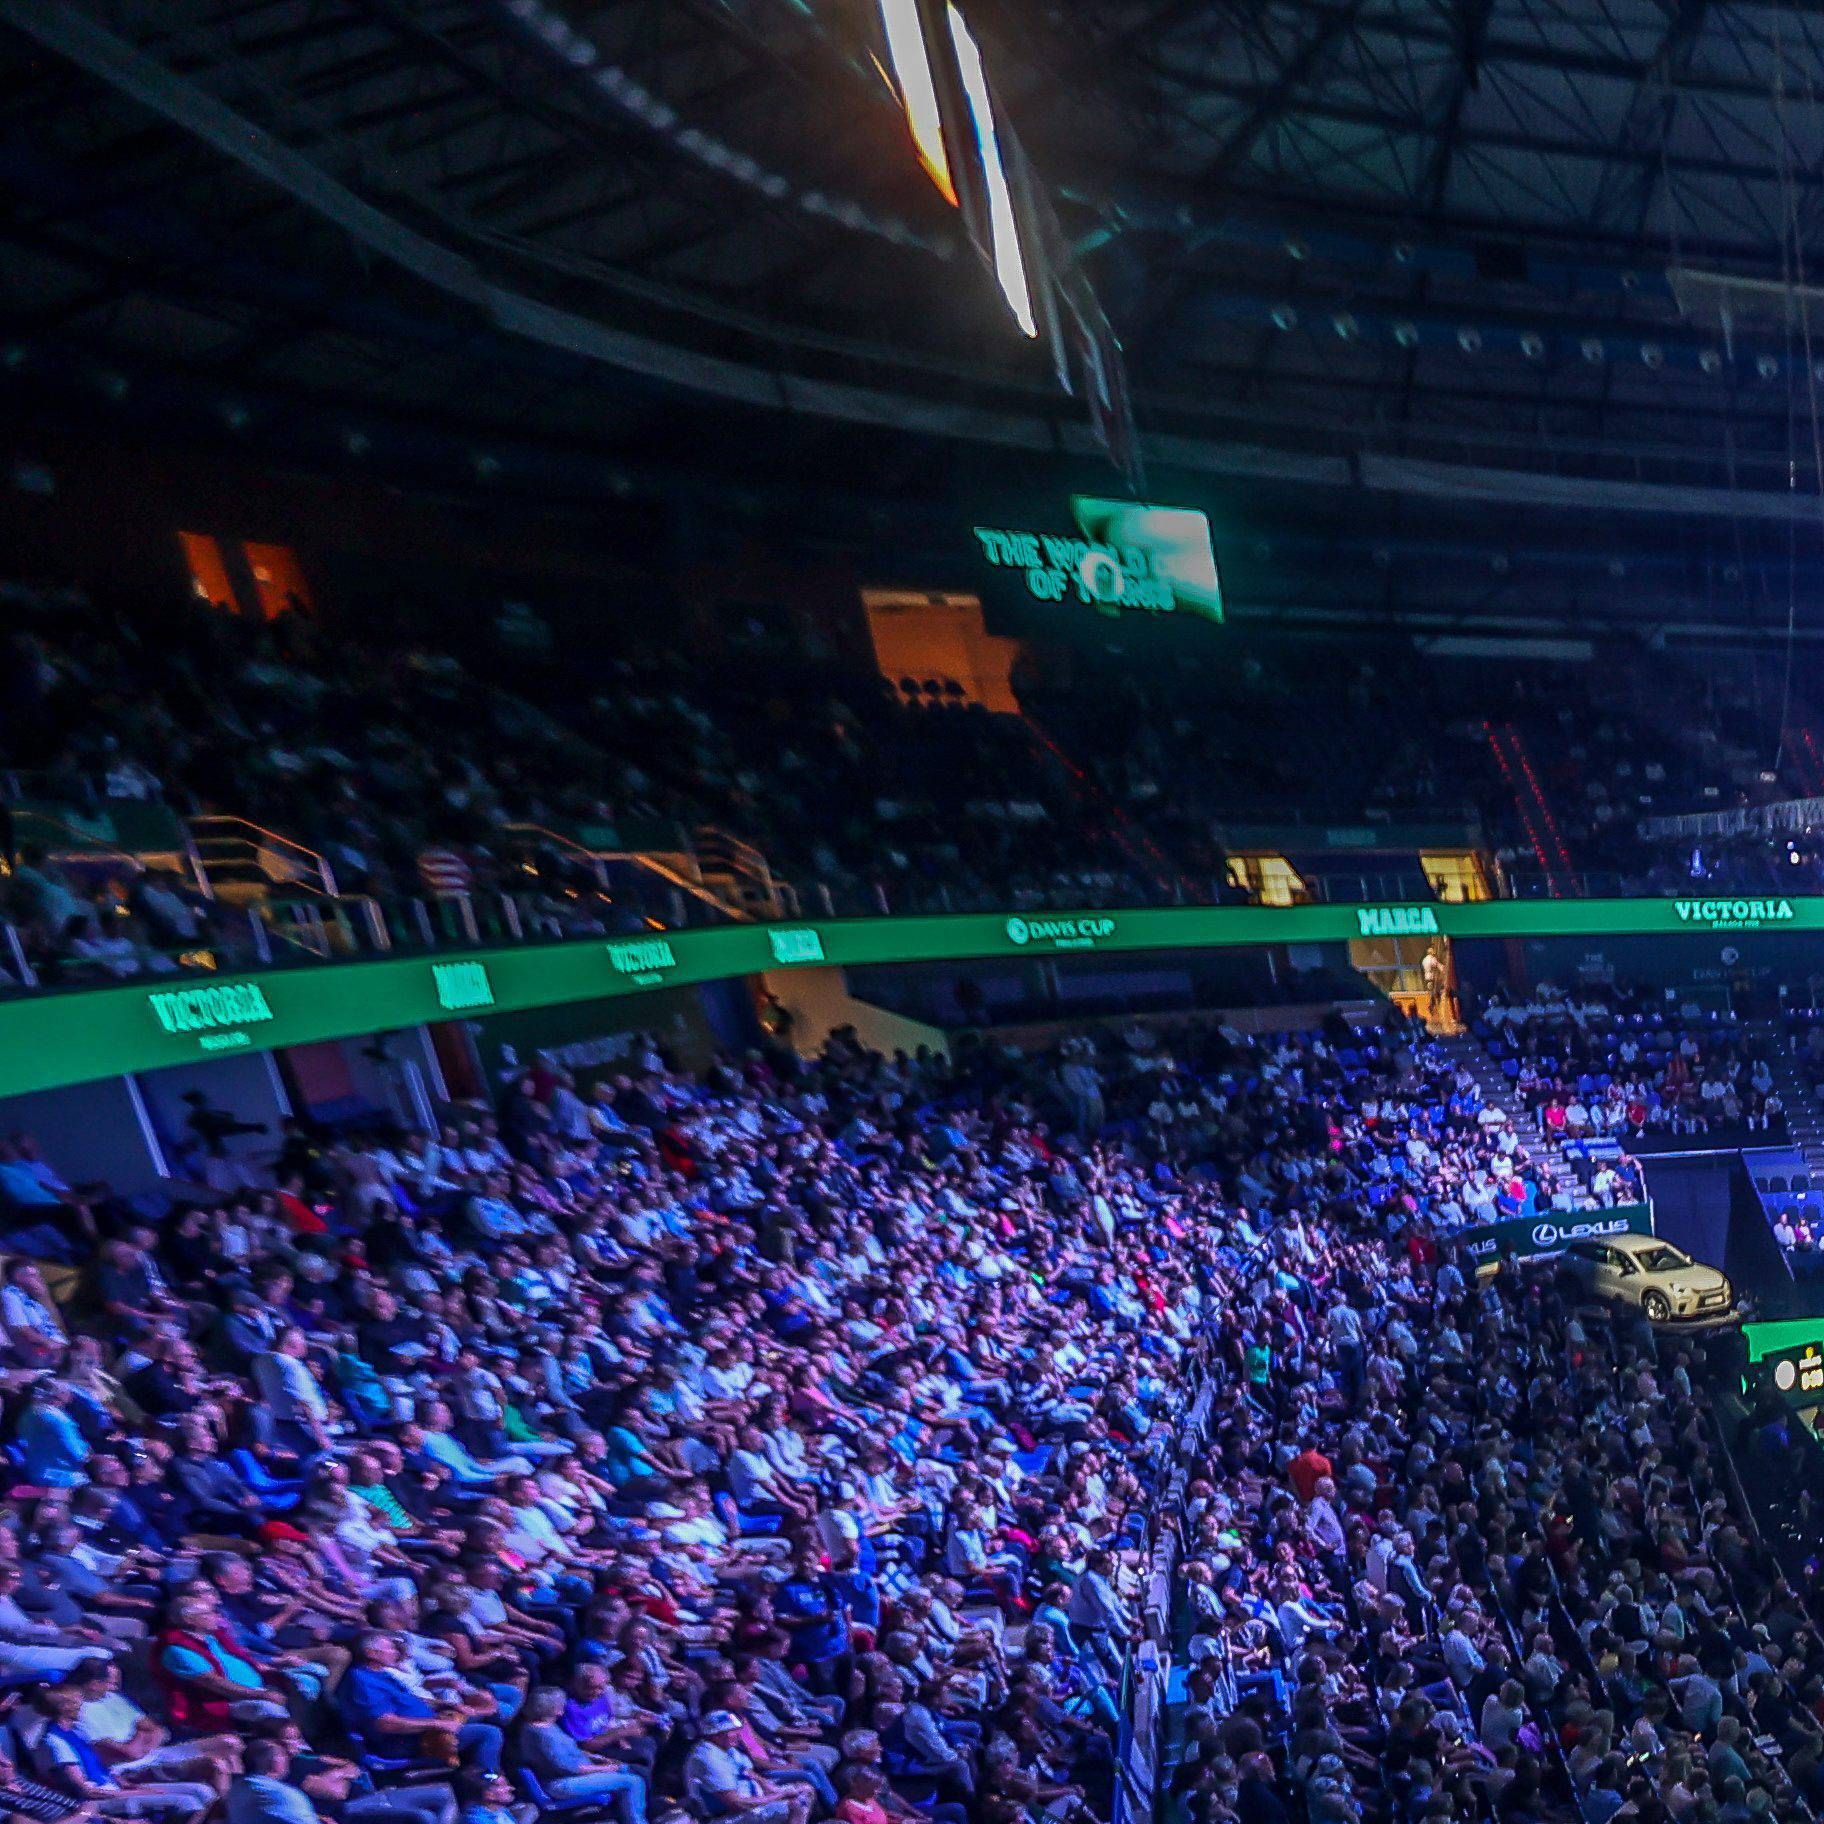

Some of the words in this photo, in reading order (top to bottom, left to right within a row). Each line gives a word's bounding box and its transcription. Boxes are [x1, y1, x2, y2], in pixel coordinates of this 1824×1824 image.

[1357, 906, 1438, 936] MARCA
[1674, 900, 1794, 923] VICTORIA
[1558, 1217, 1630, 1240] LEXUS
